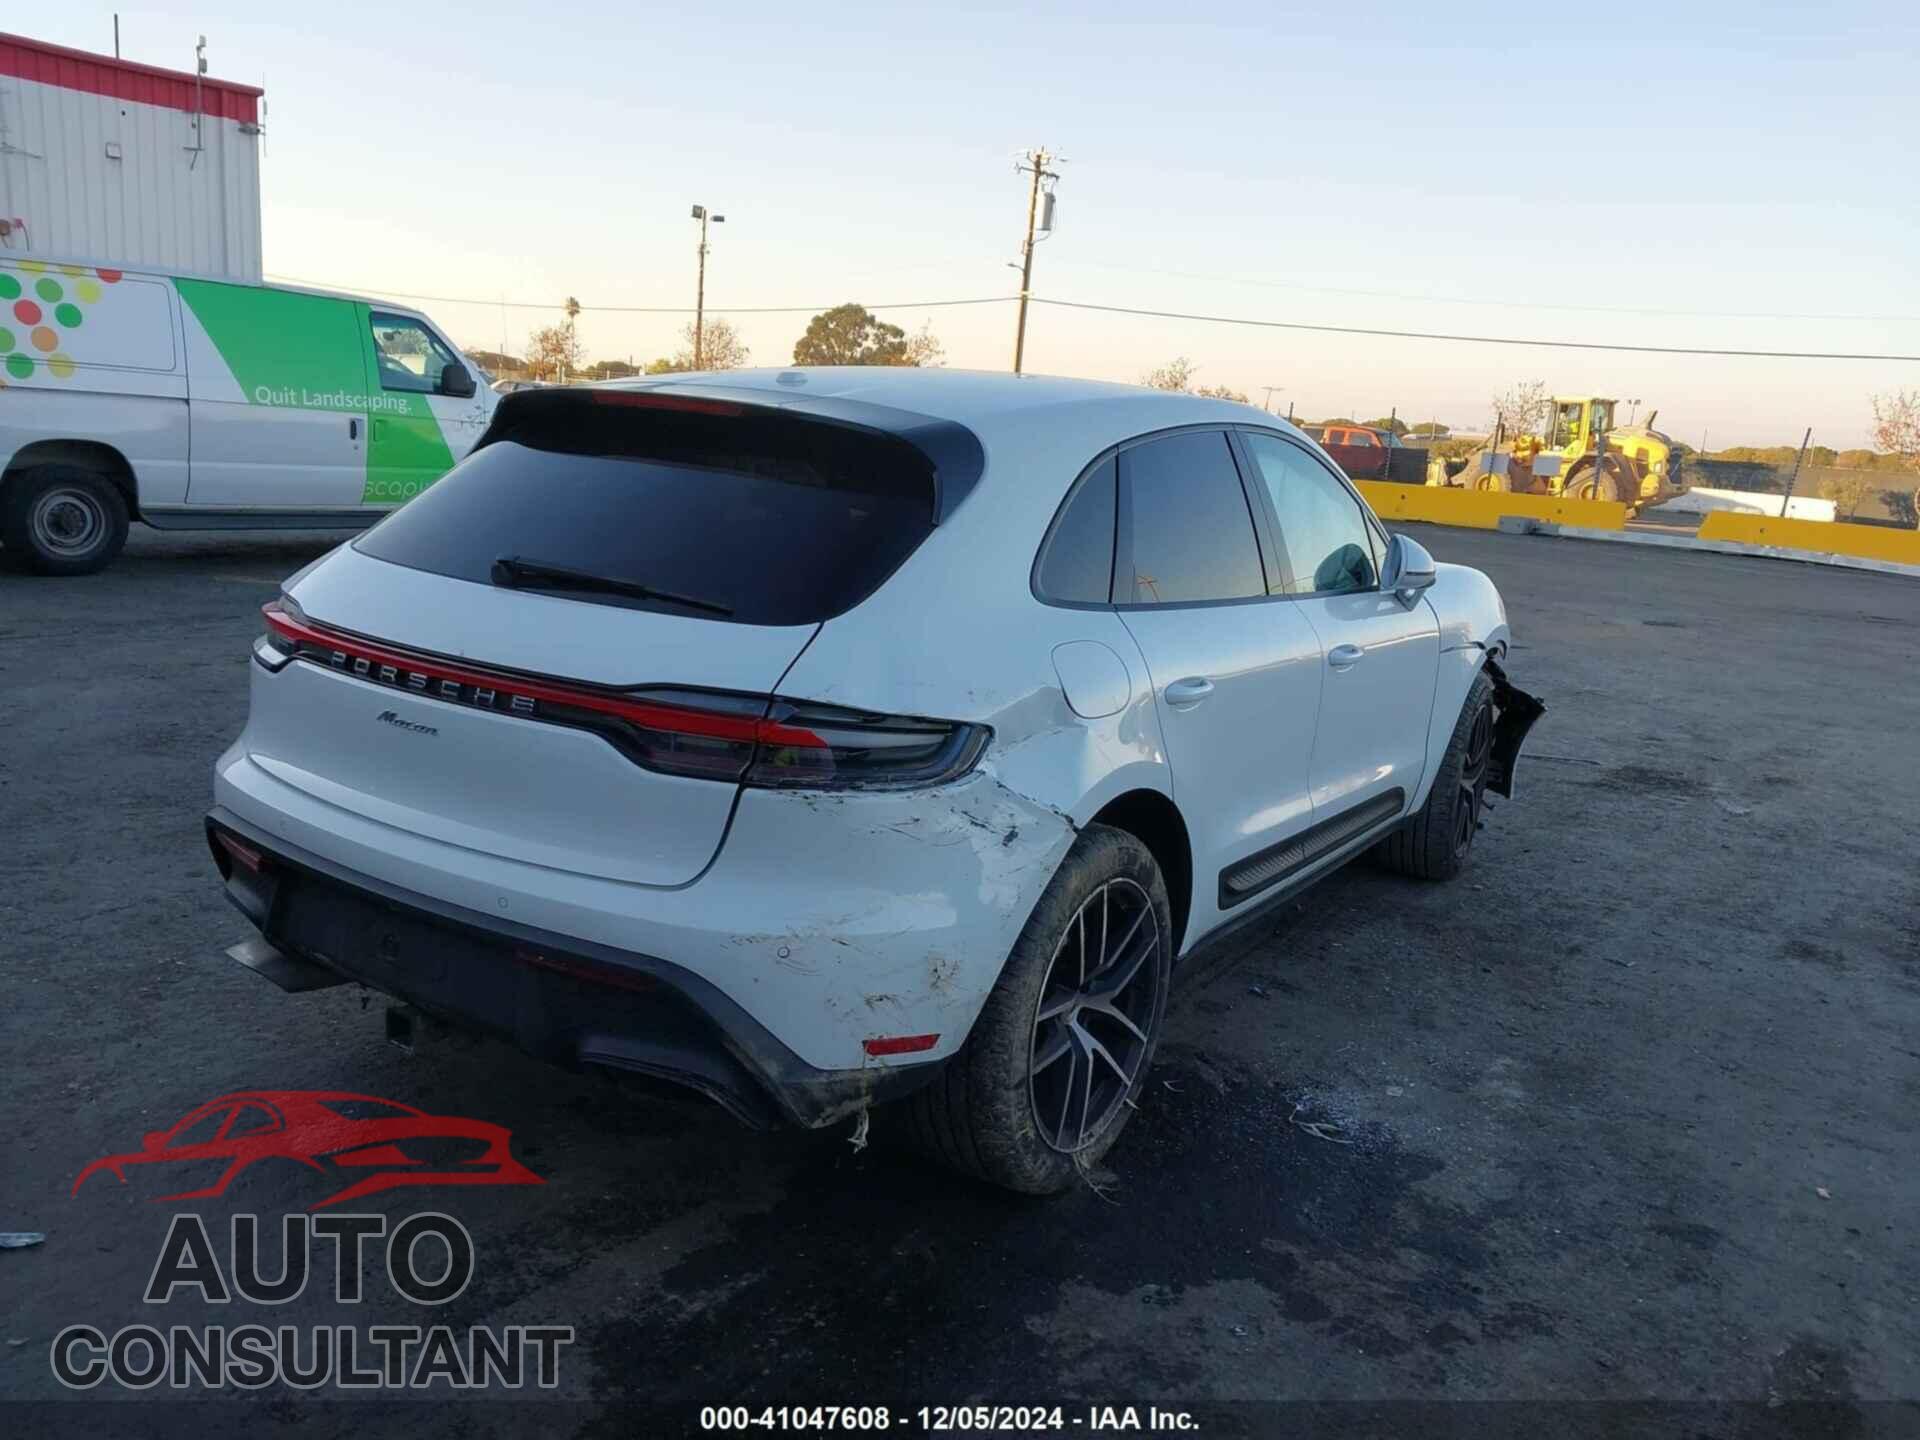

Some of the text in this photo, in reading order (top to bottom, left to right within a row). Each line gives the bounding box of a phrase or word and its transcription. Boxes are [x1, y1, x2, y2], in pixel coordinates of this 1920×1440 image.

[255, 386, 412, 415] Quit Landscaping.
[328, 650, 536, 714] PORSCHE
[376, 710, 440, 737] Macan
